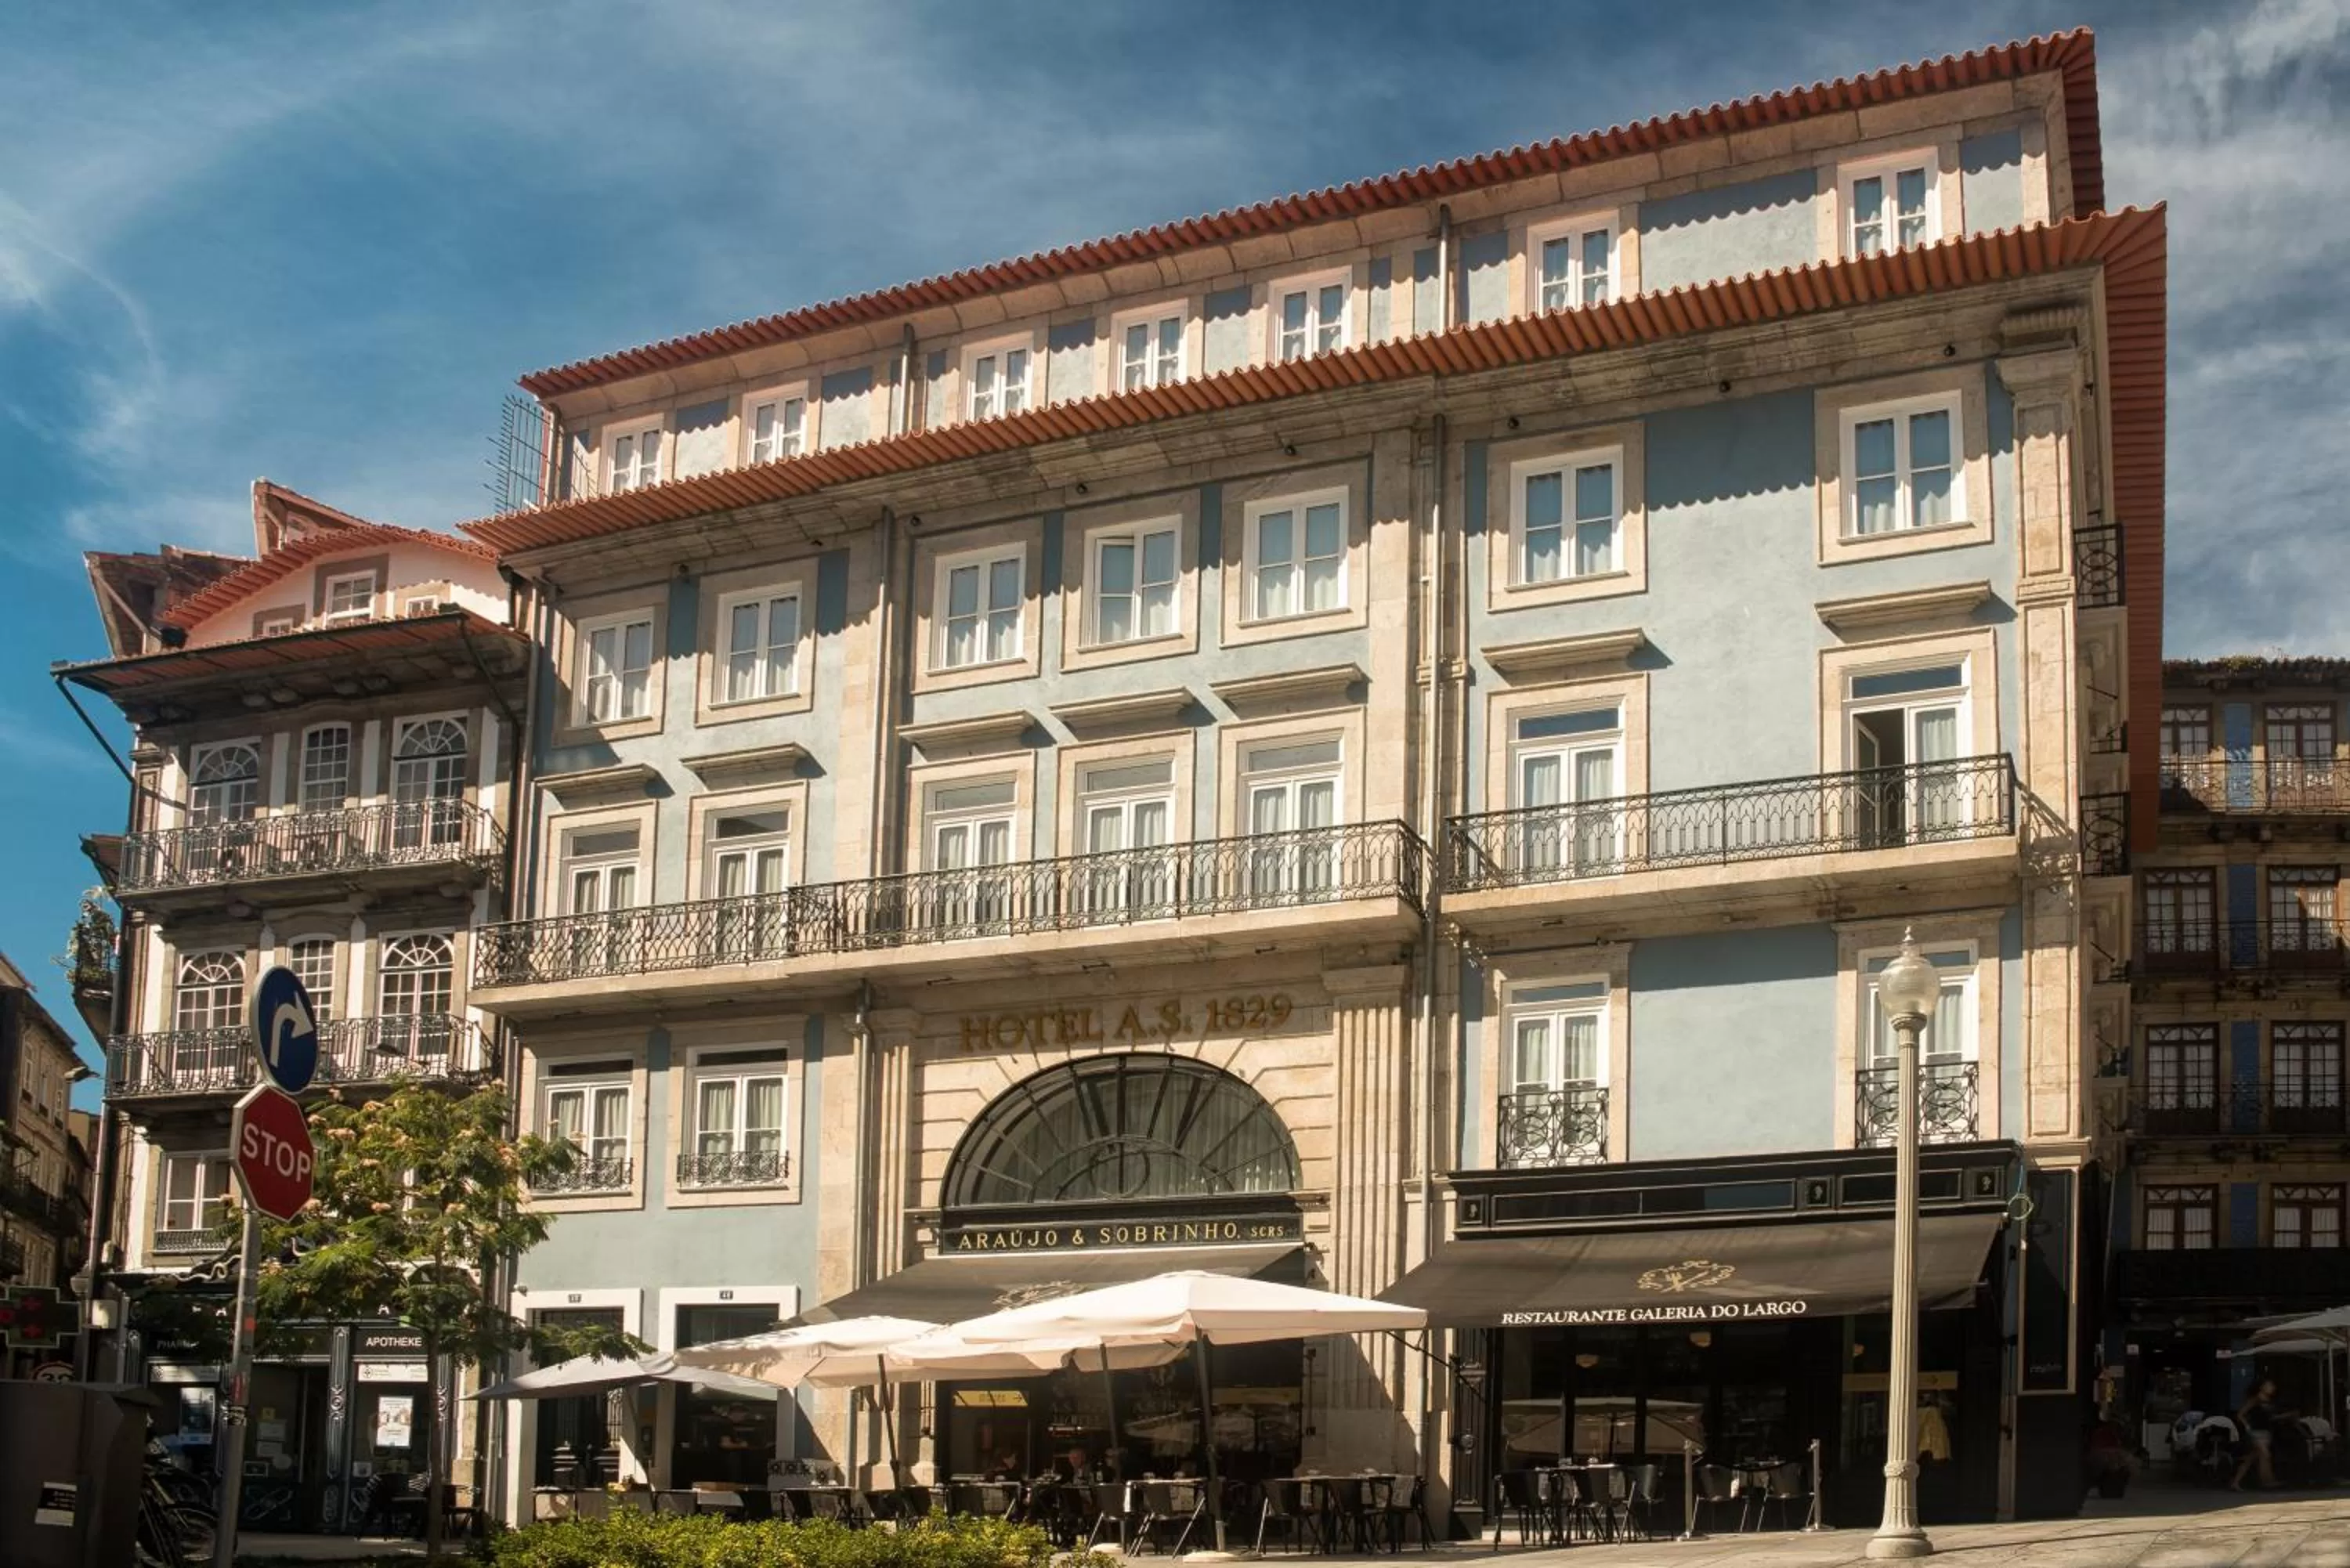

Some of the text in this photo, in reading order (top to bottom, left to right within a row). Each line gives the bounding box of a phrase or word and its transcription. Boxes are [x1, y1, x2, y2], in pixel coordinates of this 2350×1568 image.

[958, 1004, 1104, 1053] HOTEL
[1205, 992, 1293, 1034] 1829
[242, 1123, 312, 1183] STOP
[958, 1228, 1058, 1251] ARAÚJO
[1072, 1228, 1085, 1245] &
[1501, 1300, 1807, 1325] RESTAURANTE GALERIA DO LARGO
[365, 1336, 423, 1348] APOTHEKE
